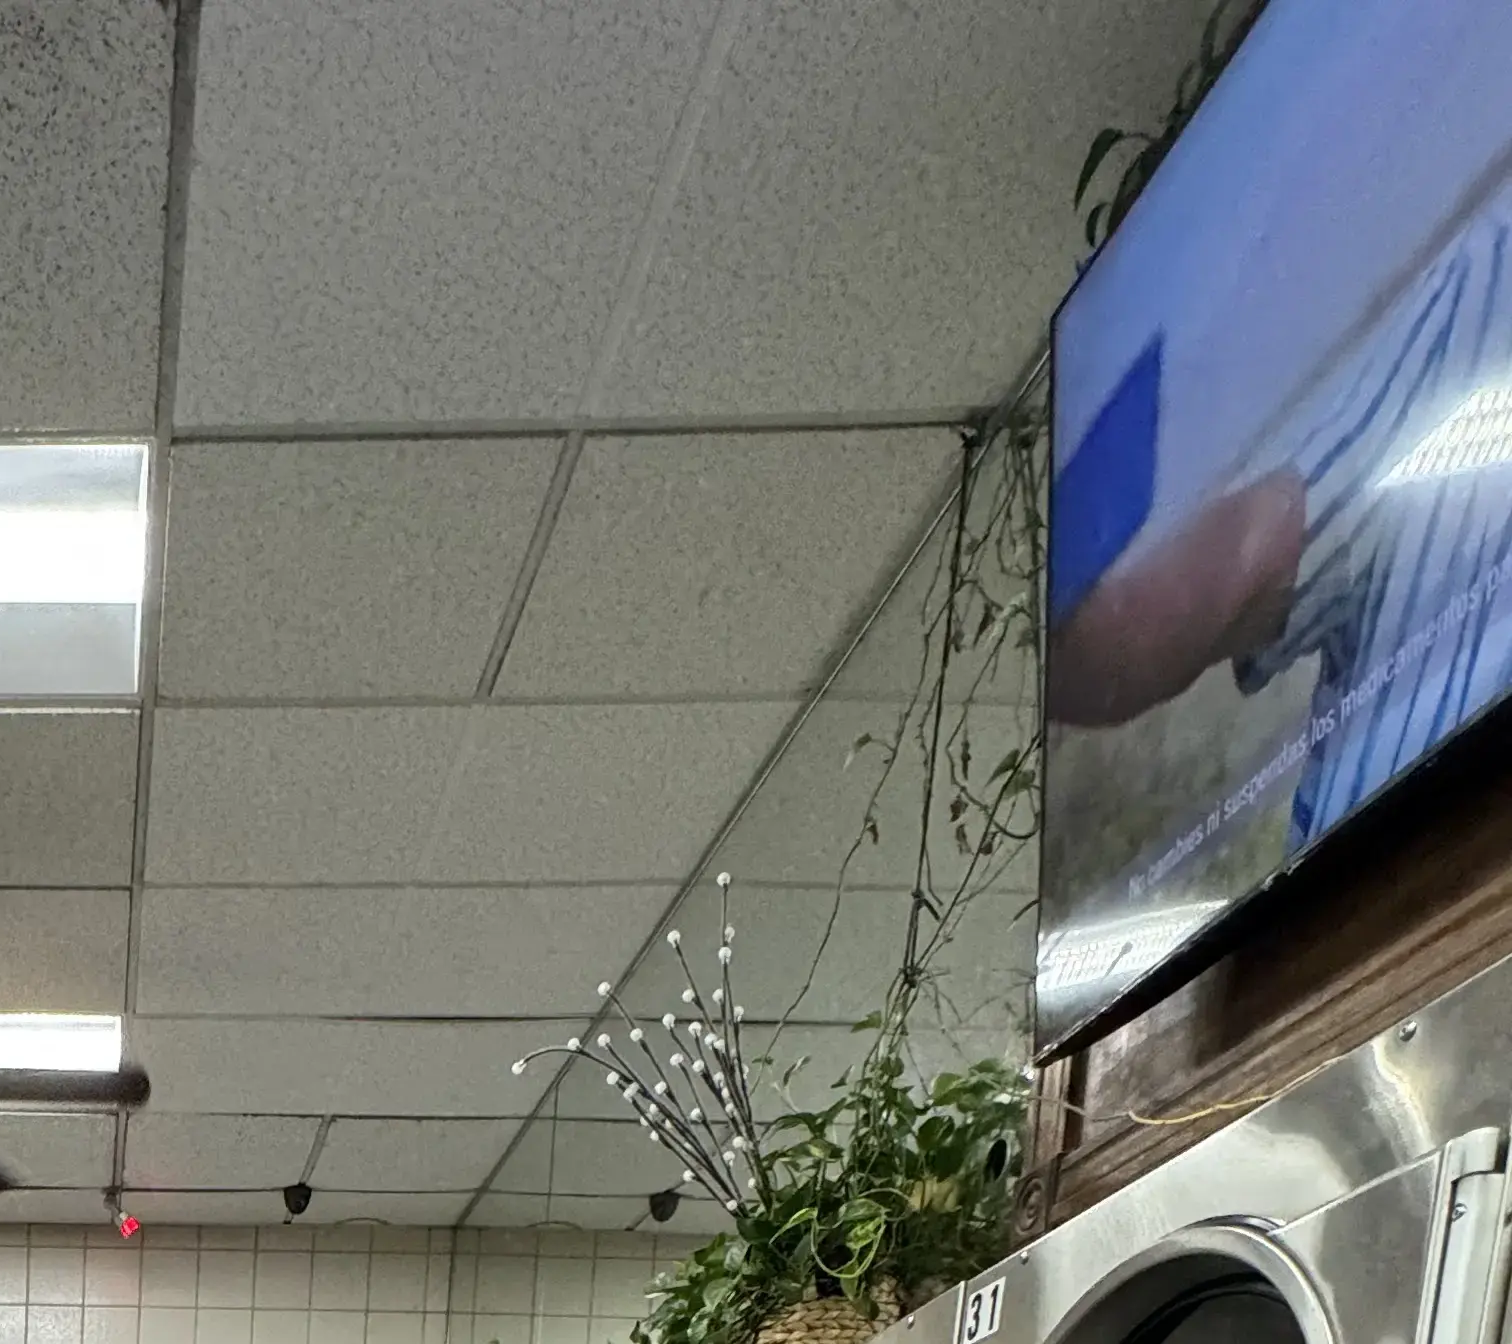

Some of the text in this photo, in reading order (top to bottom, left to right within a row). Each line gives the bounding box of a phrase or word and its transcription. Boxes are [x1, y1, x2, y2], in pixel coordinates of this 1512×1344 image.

[1207, 801, 1221, 836] ni
[1223, 732, 1308, 821] suspendas
[1311, 708, 1336, 746] los
[1340, 584, 1482, 725] medicamentos
[967, 1284, 1000, 1341] 31
